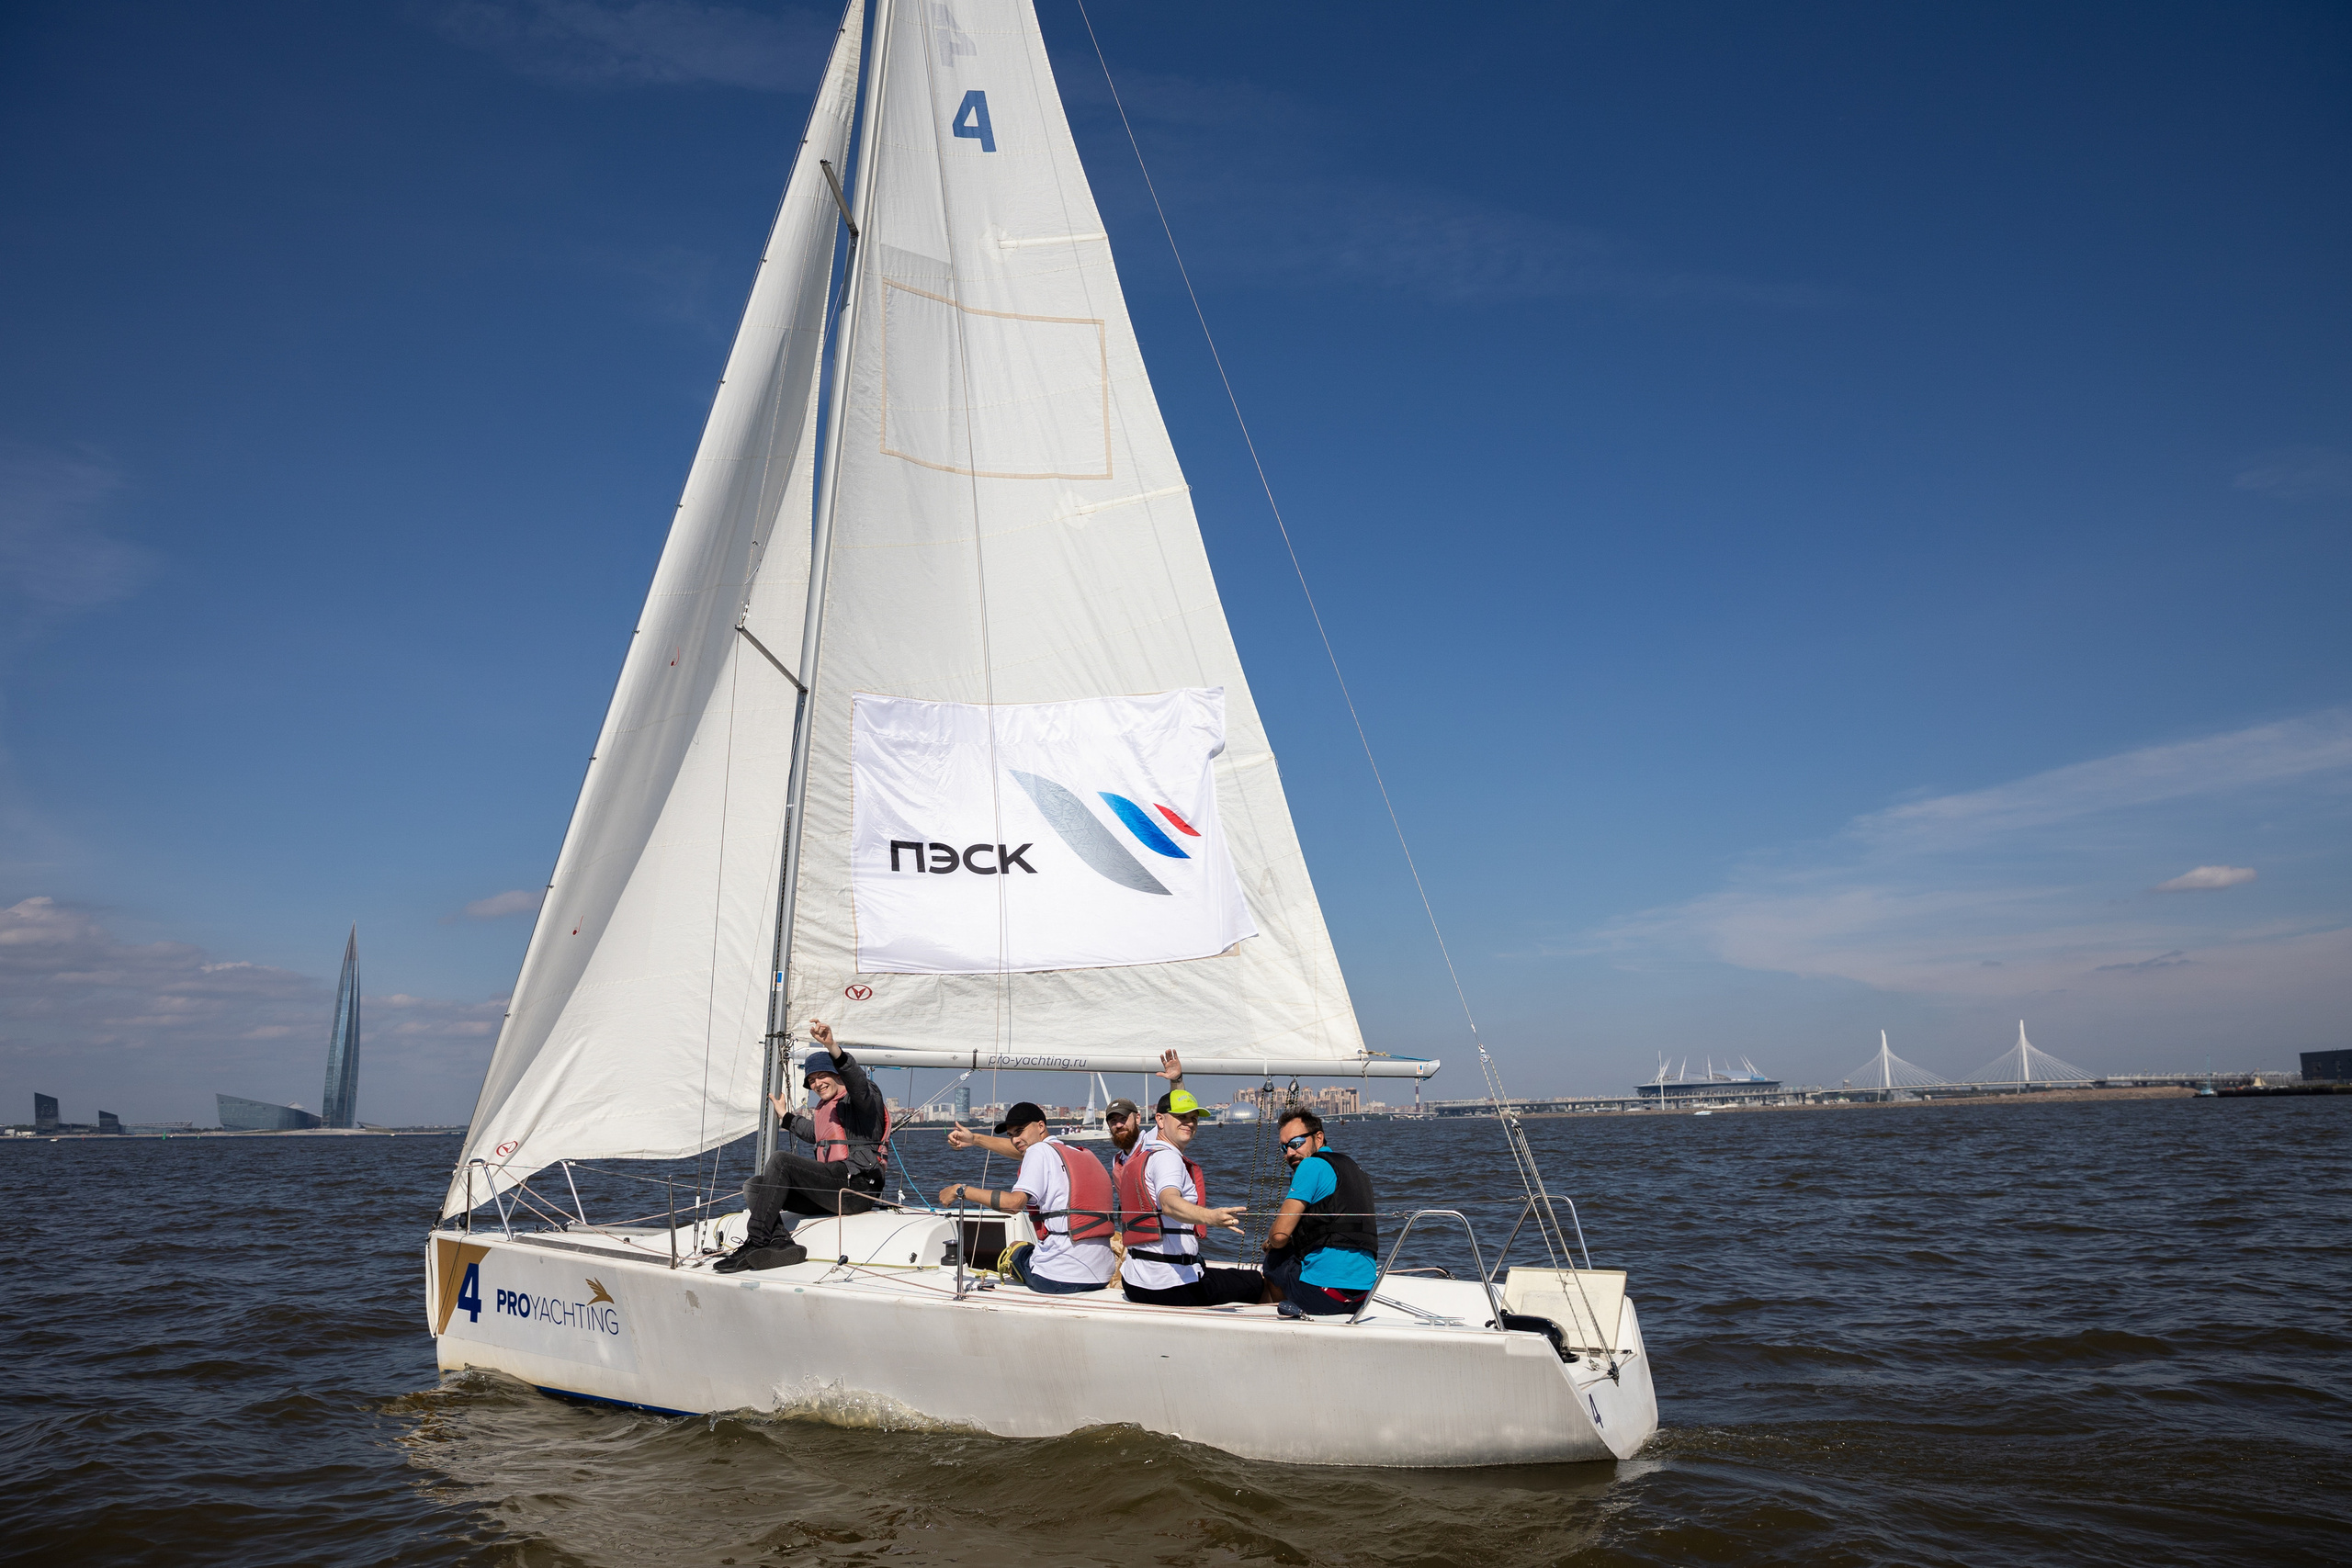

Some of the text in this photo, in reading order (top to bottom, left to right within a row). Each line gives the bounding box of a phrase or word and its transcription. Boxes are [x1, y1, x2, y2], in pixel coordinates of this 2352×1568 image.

[952, 89, 997, 152] 4
[889, 840, 1038, 875] ПЭСК
[989, 1055, 1086, 1069] pro-yachting.ru
[458, 1262, 481, 1323] 4
[496, 1288, 619, 1336] PROYACHTING
[1589, 1393, 1603, 1428] 4
